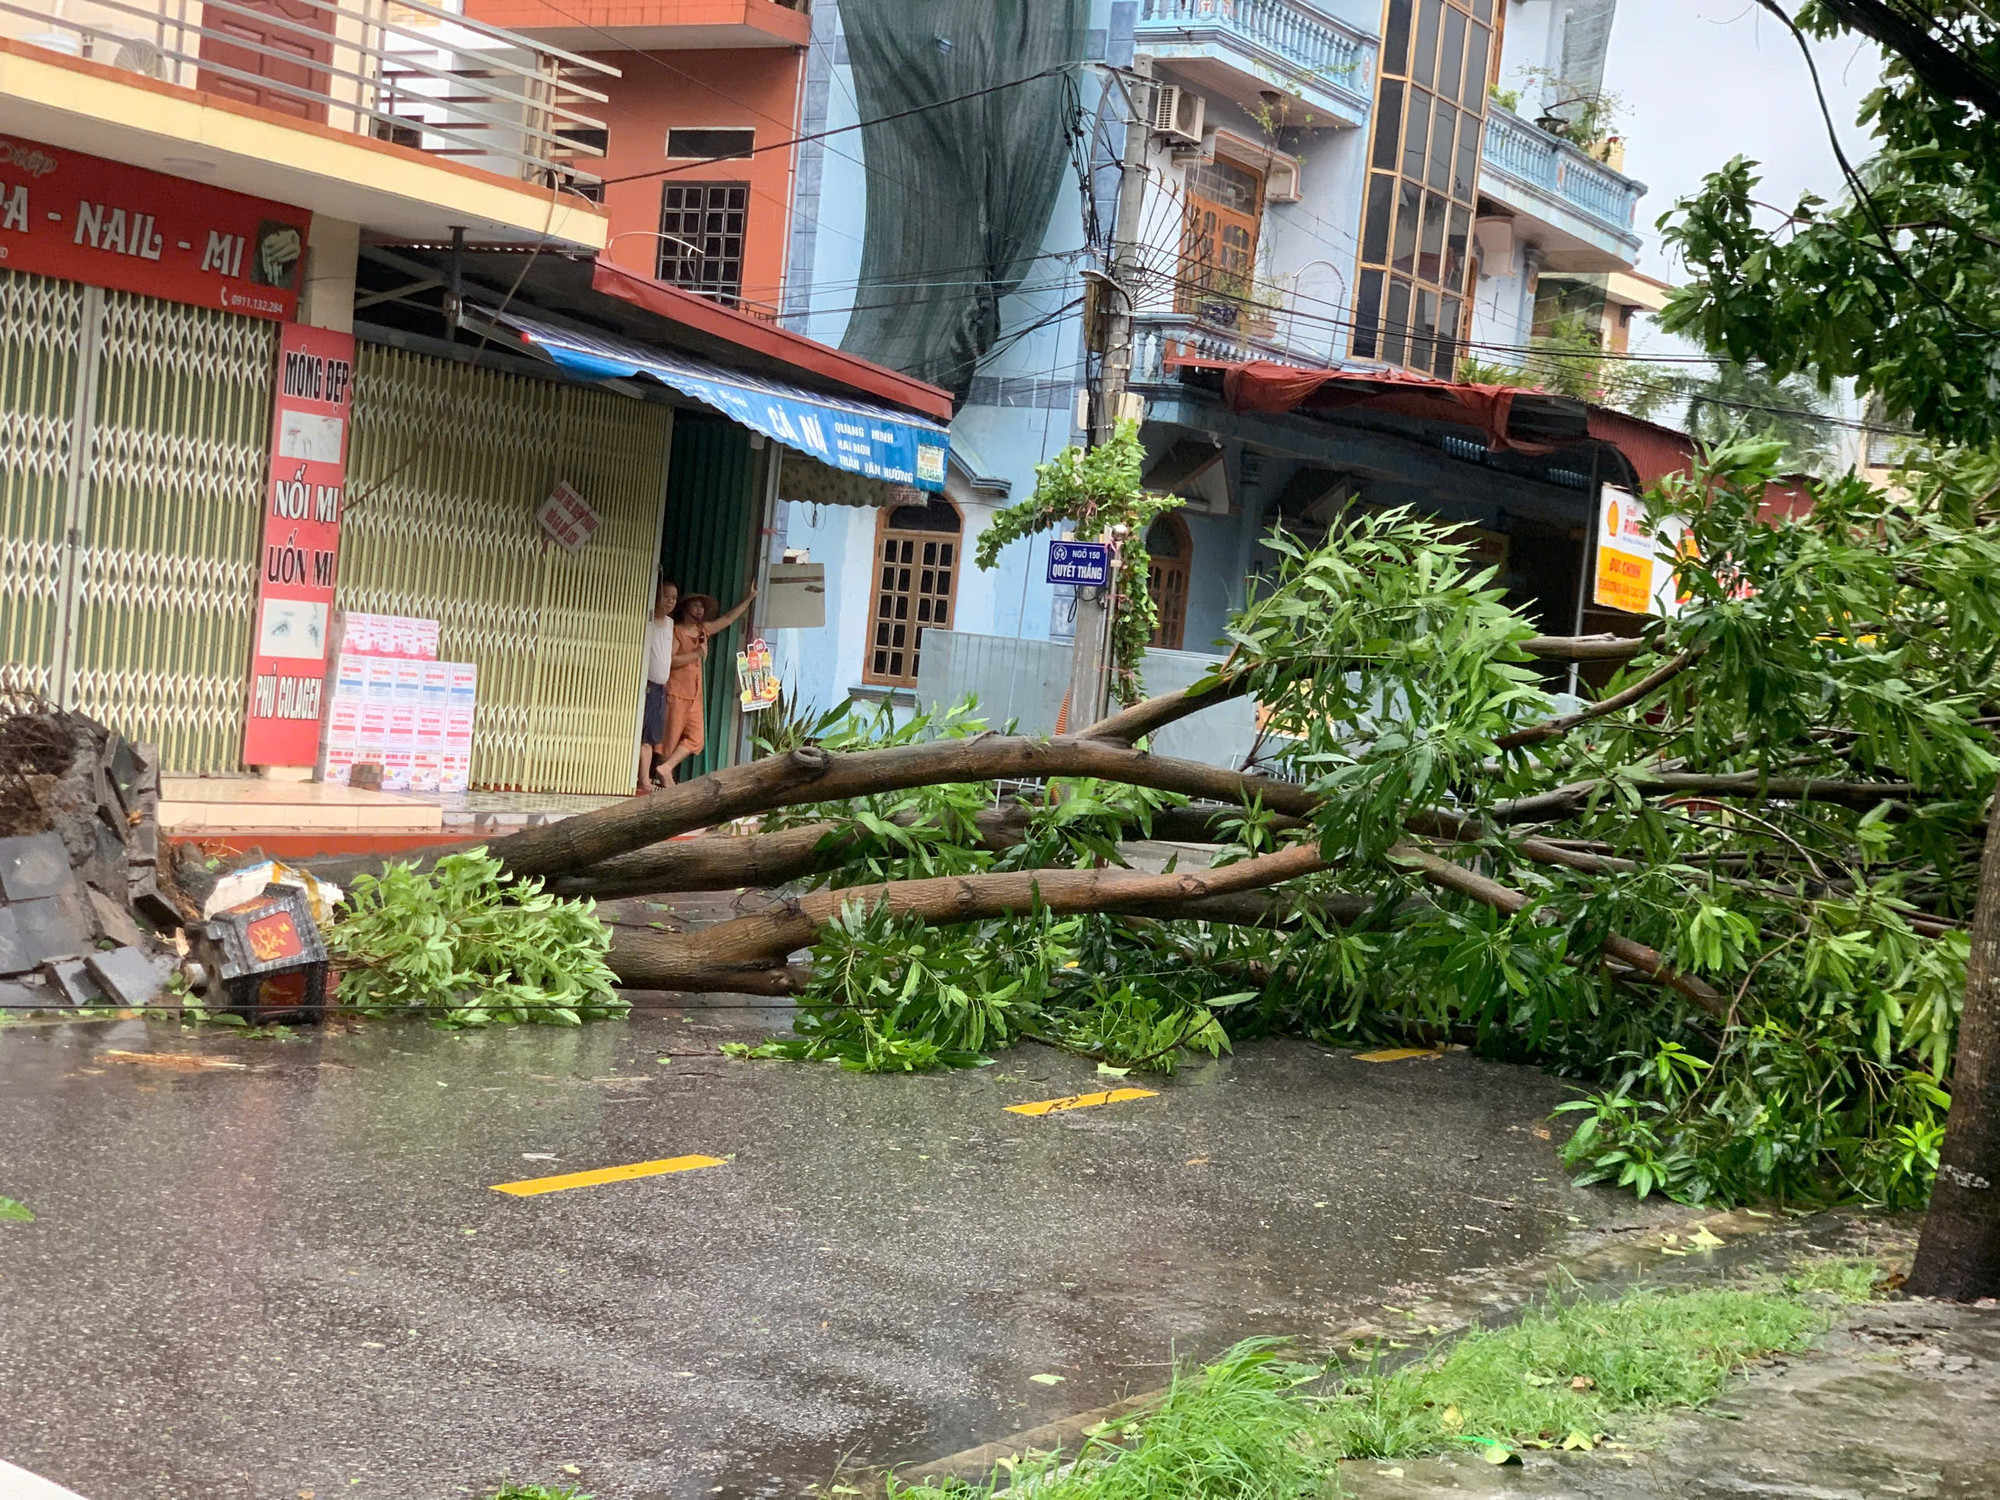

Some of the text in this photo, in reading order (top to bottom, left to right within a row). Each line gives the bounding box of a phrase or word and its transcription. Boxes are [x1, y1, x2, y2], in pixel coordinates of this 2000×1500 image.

[0, 182, 29, 233] A
[74, 200, 163, 261] NAIL
[201, 230, 245, 278] MI
[283, 344, 350, 414] MÓNG ĐẸP
[834, 421, 894, 445] QUANG MINH
[273, 463, 340, 524] NỐI MI
[267, 528, 334, 590] UỐN MI
[1052, 560, 1103, 580] QUYẾT THẮNG
[1072, 548, 1100, 560] NGÕ 150
[276, 676, 322, 720] COLAGEN
